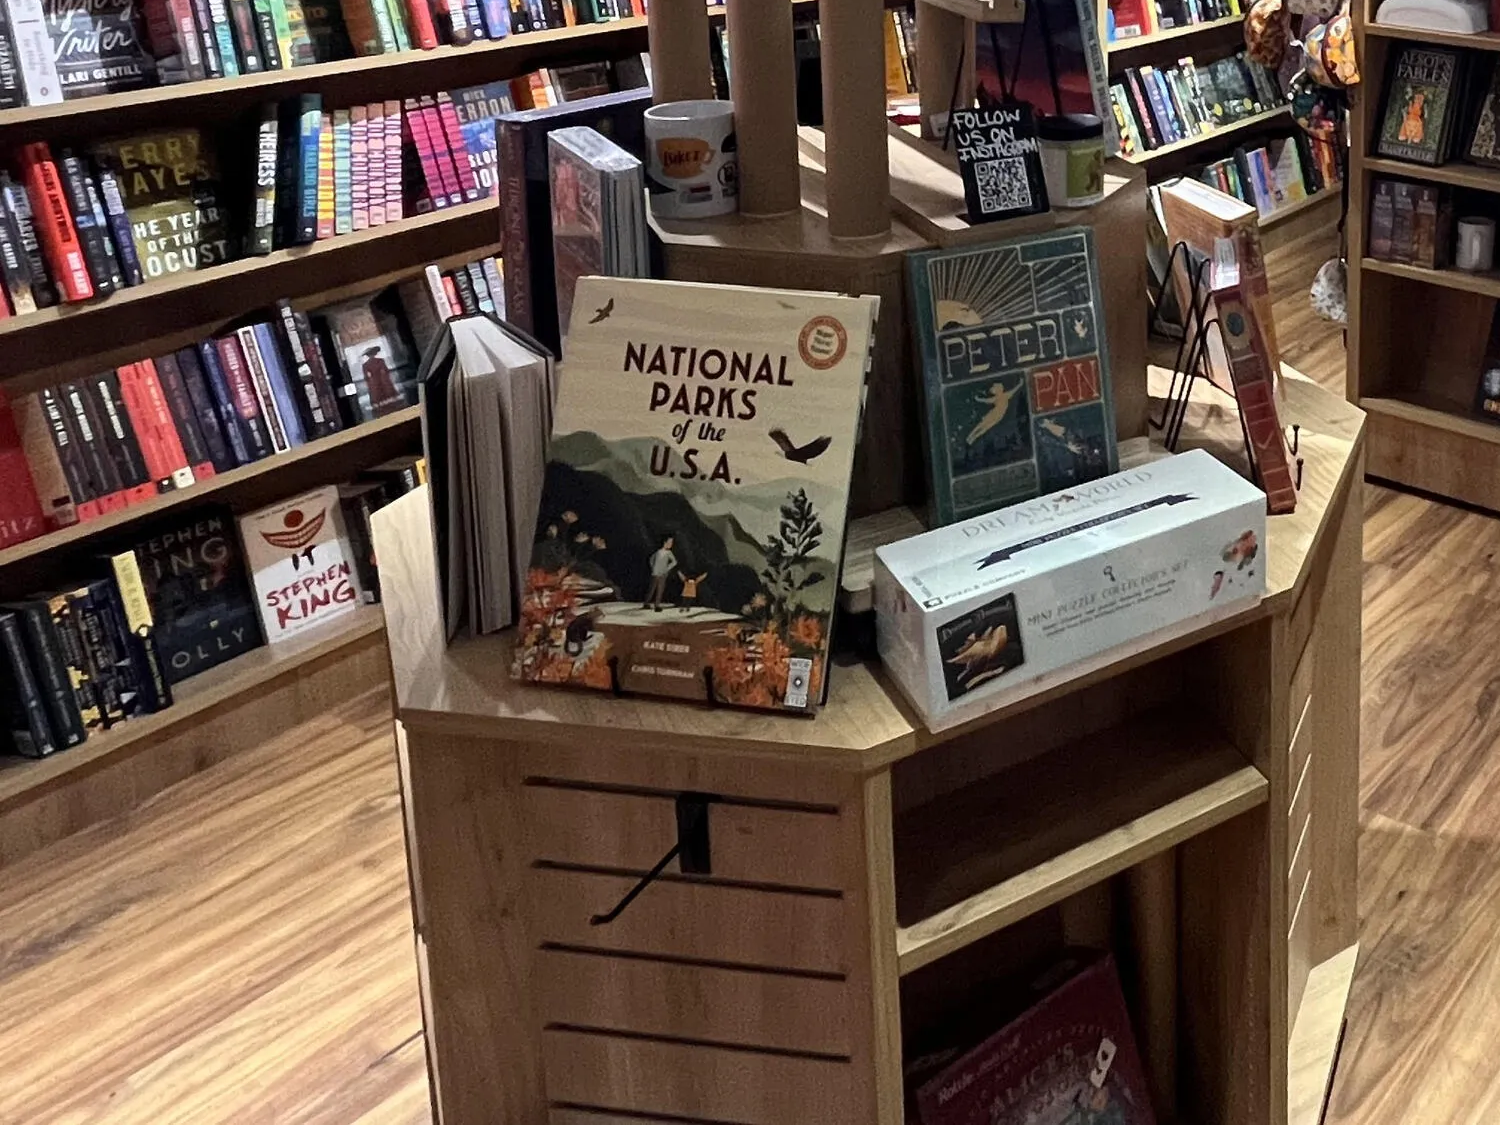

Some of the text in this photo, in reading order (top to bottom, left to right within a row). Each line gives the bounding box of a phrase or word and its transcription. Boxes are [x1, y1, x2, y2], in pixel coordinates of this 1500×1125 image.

[92, 63, 142, 81] GENTILL
[1396, 63, 1450, 84] FABLES
[1401, 50, 1452, 69] AESOP'S
[456, 100, 512, 123] ERRON
[952, 108, 1021, 130] FOLLOW
[118, 132, 199, 170] ERRY
[958, 127, 1015, 146] US ON
[958, 137, 1039, 162] INSTAGRAM
[256, 132, 278, 187] HEIRESS
[133, 207, 220, 240] HE YEAR
[145, 240, 231, 279] OCUST
[146, 237, 168, 253] OF
[623, 341, 795, 386] NATIONAL
[944, 320, 1062, 378] PETER
[649, 382, 757, 420] PARKS
[1034, 361, 1100, 409] PAN
[671, 420, 726, 444] of the
[649, 445, 742, 484] U.S.A.
[961, 470, 1154, 539] DREAM WORLD
[136, 516, 223, 556] TEPHEN
[291, 543, 316, 571] IT
[265, 560, 351, 607] STEPHEN
[276, 579, 357, 629] KING
[1056, 593, 1098, 616] PUZZLE
[171, 626, 246, 669] OLLY
